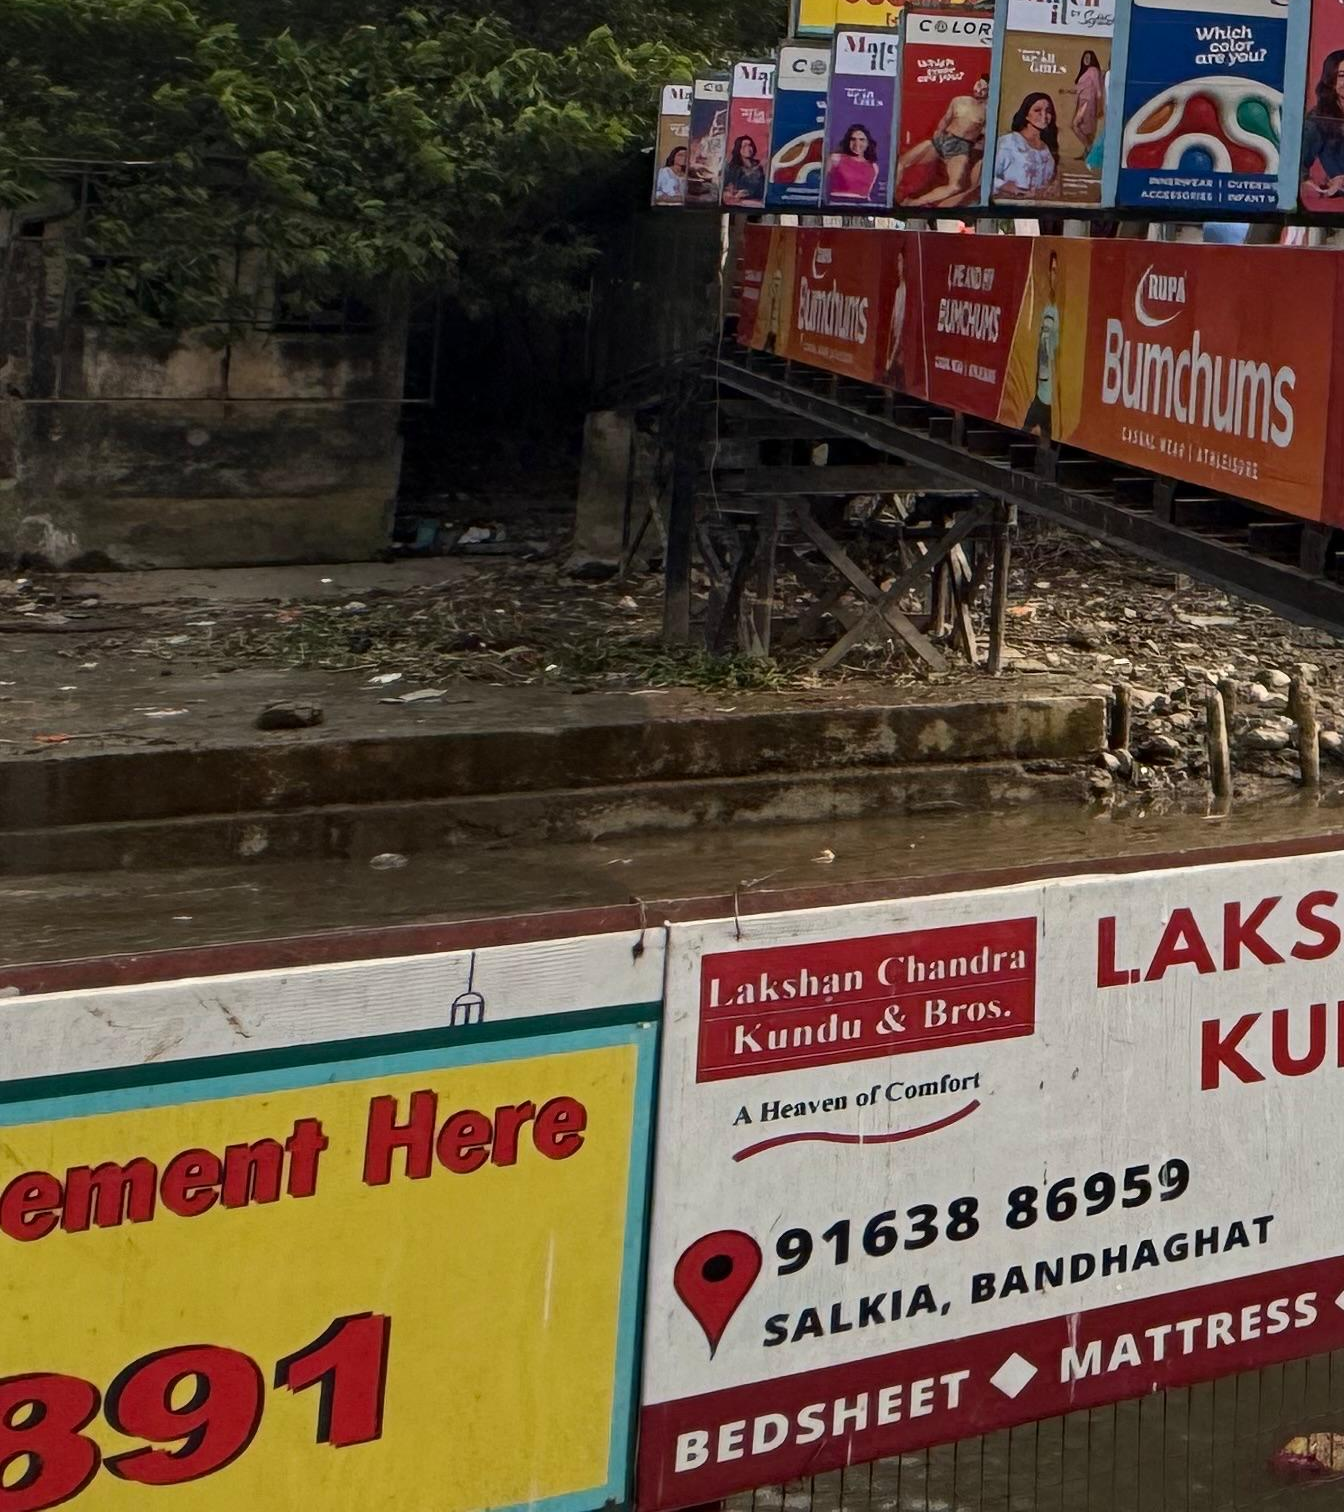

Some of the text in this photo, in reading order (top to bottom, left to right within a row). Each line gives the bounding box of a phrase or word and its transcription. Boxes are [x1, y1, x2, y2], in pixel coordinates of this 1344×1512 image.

[919, 19, 991, 34] COLOR
[1195, 24, 1253, 41] Which
[1209, 38, 1255, 53] color
[1195, 50, 1268, 68] are you?
[1148, 272, 1187, 304] RUPA
[1101, 318, 1297, 449] Bumchums
[709, 944, 1027, 1009] Lakshan Chandra
[733, 994, 1013, 1056] Kundu & Bros.
[732, 1070, 982, 1127] A Heaven of Comfort
[362, 1089, 588, 1187] Here
[775, 1157, 1191, 1276] 91638 86959
[762, 1214, 1275, 1348] SALKIA, BANDHAGHAT
[674, 1369, 970, 1474] BEDSHEET
[1059, 1291, 1319, 1384] MATTRESS
